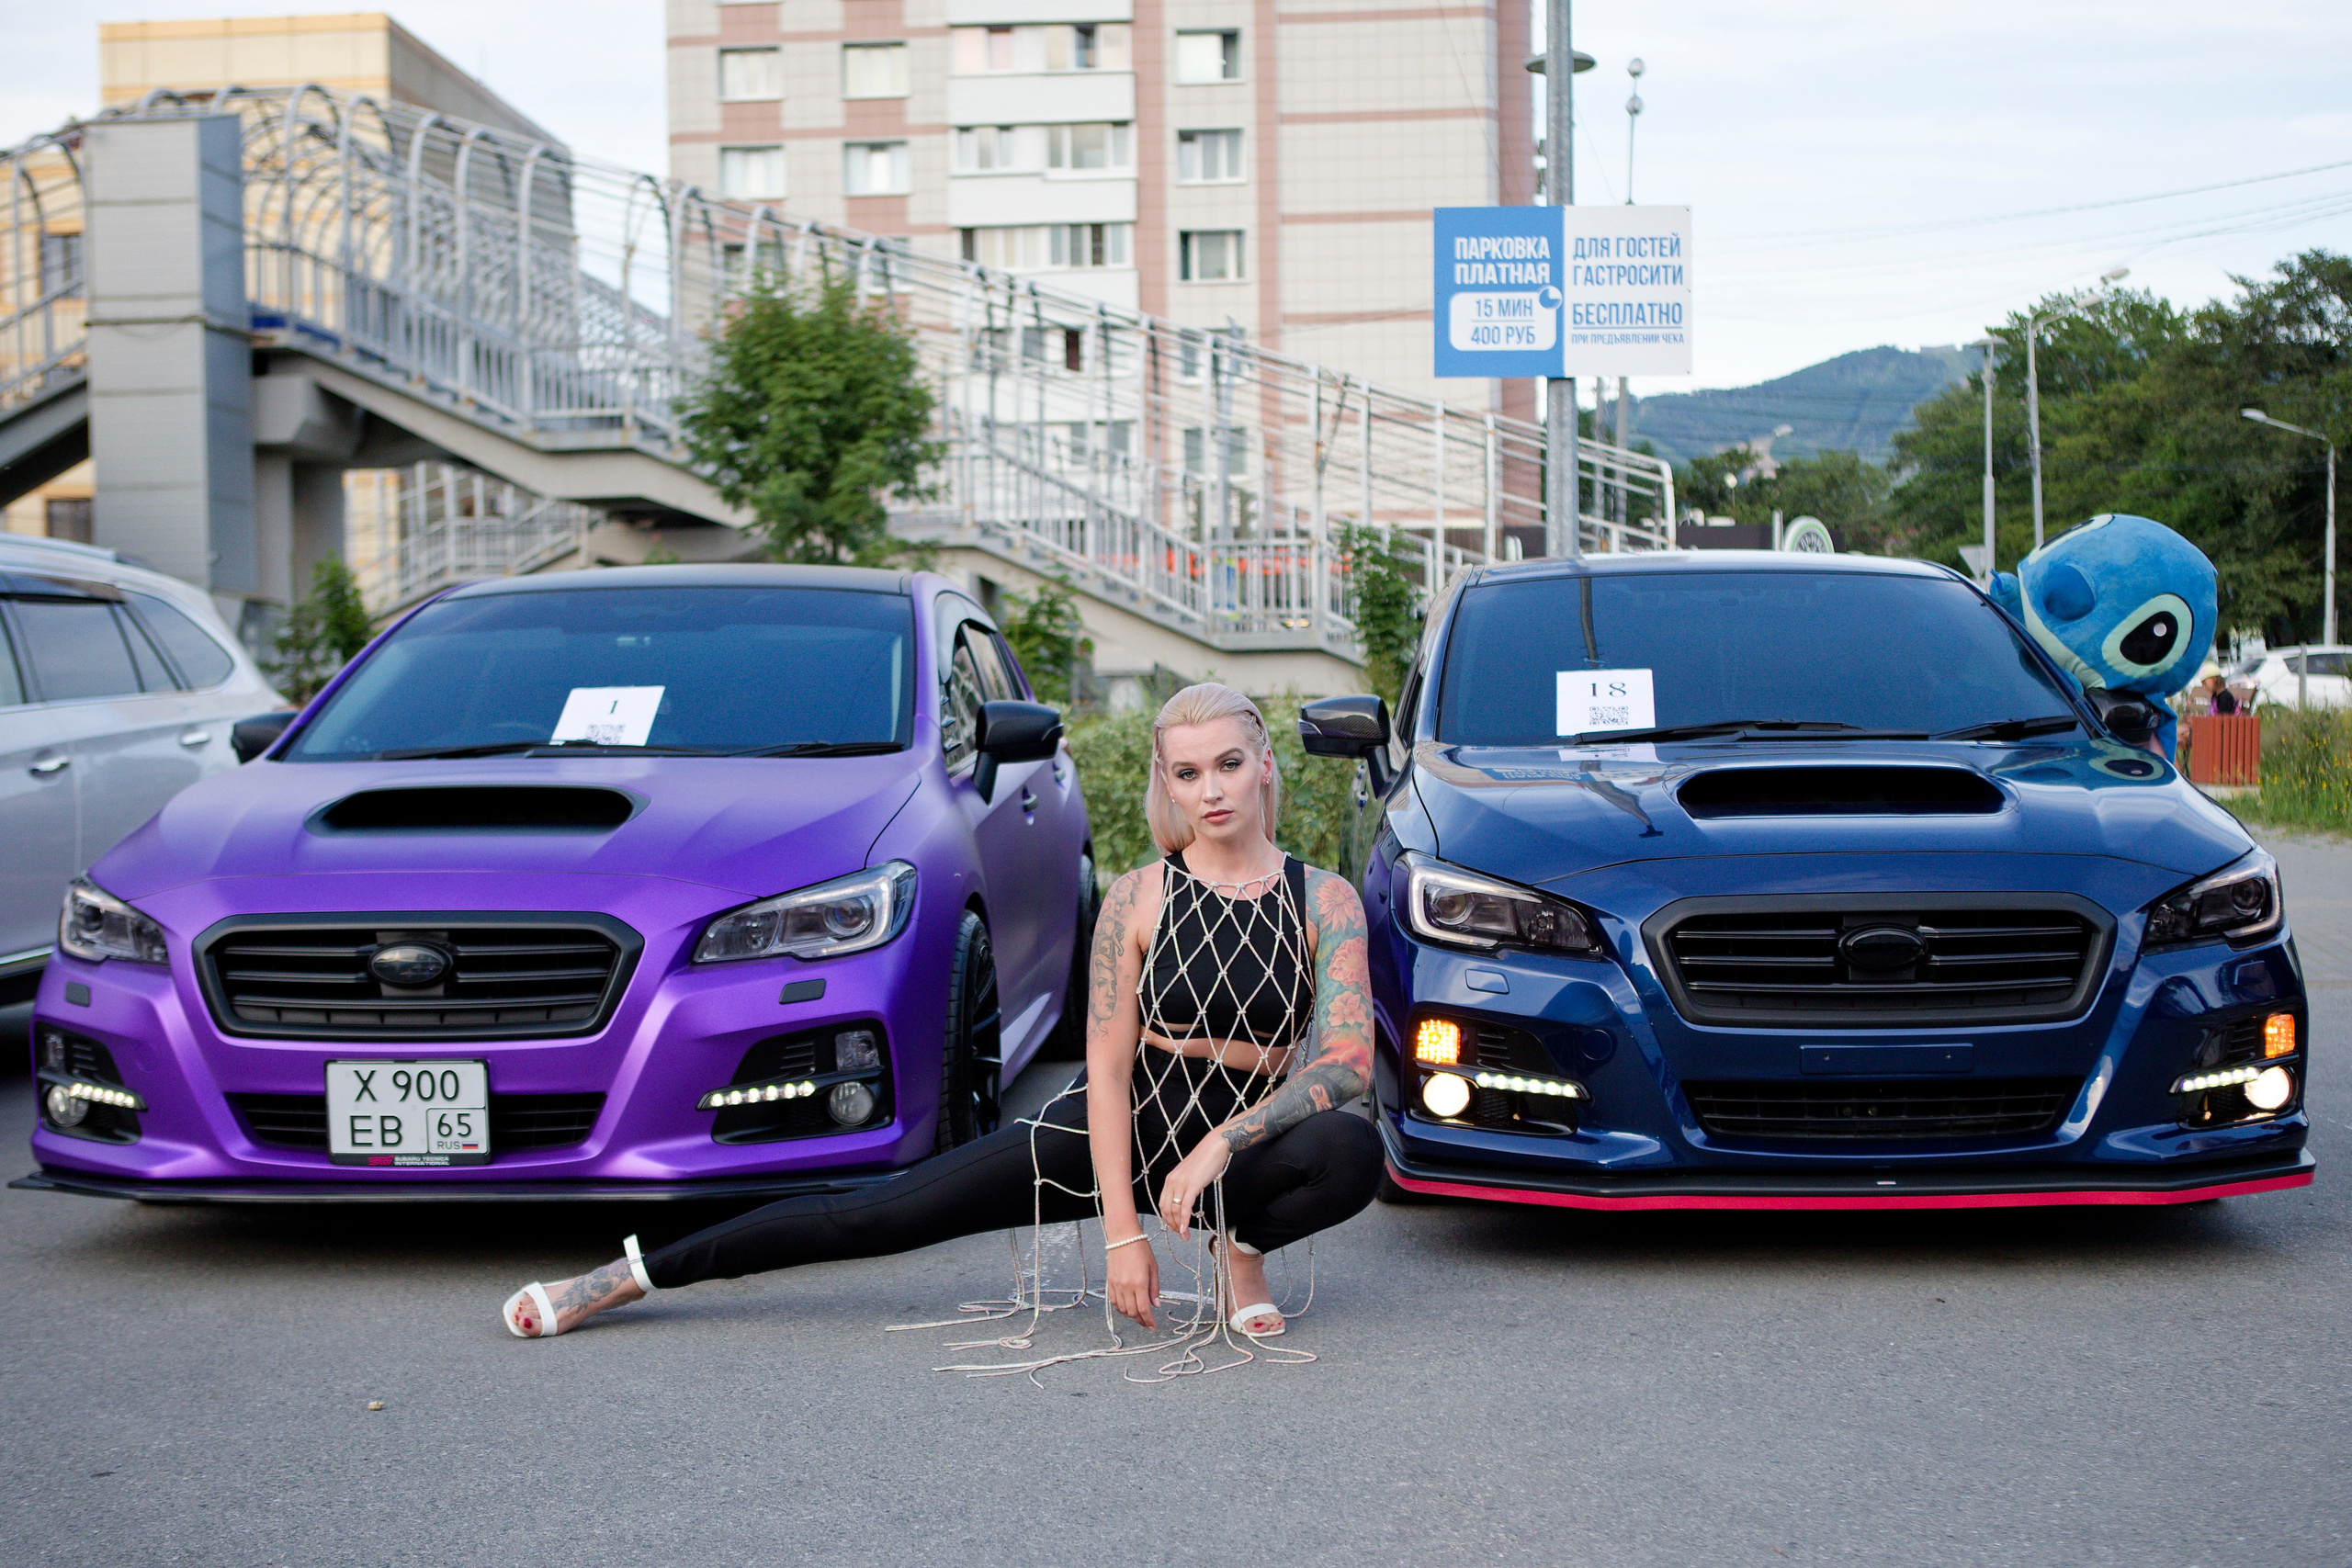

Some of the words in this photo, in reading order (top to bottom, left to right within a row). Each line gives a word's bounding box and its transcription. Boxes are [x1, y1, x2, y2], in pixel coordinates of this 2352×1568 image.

[1454, 236, 1550, 260] ПАРКОВКА
[1573, 237, 1610, 260] ДЛЯ
[1616, 232, 1681, 258] ГОСТЕЙ
[1454, 263, 1550, 285] ПЛАТНАЯ
[1573, 265, 1683, 286] ГАСТРОСИТИ
[1476, 299, 1494, 318] 15
[1498, 299, 1533, 318] МИН
[1573, 302, 1683, 325] БЕСПЛАТНО
[1471, 326, 1500, 344] 400
[1506, 326, 1536, 344] РУБ
[1572, 333, 1589, 344] ПРИ
[1590, 333, 1660, 345] ПРЕДЪЯВЛЕНИИ
[1662, 333, 1684, 344] ЧЕКА
[1591, 682, 1627, 697] 18
[610, 699, 618, 714] 1
[392, 1069, 459, 1102] 900
[437, 1112, 471, 1137] 65
[436, 1141, 460, 1150] RUS
